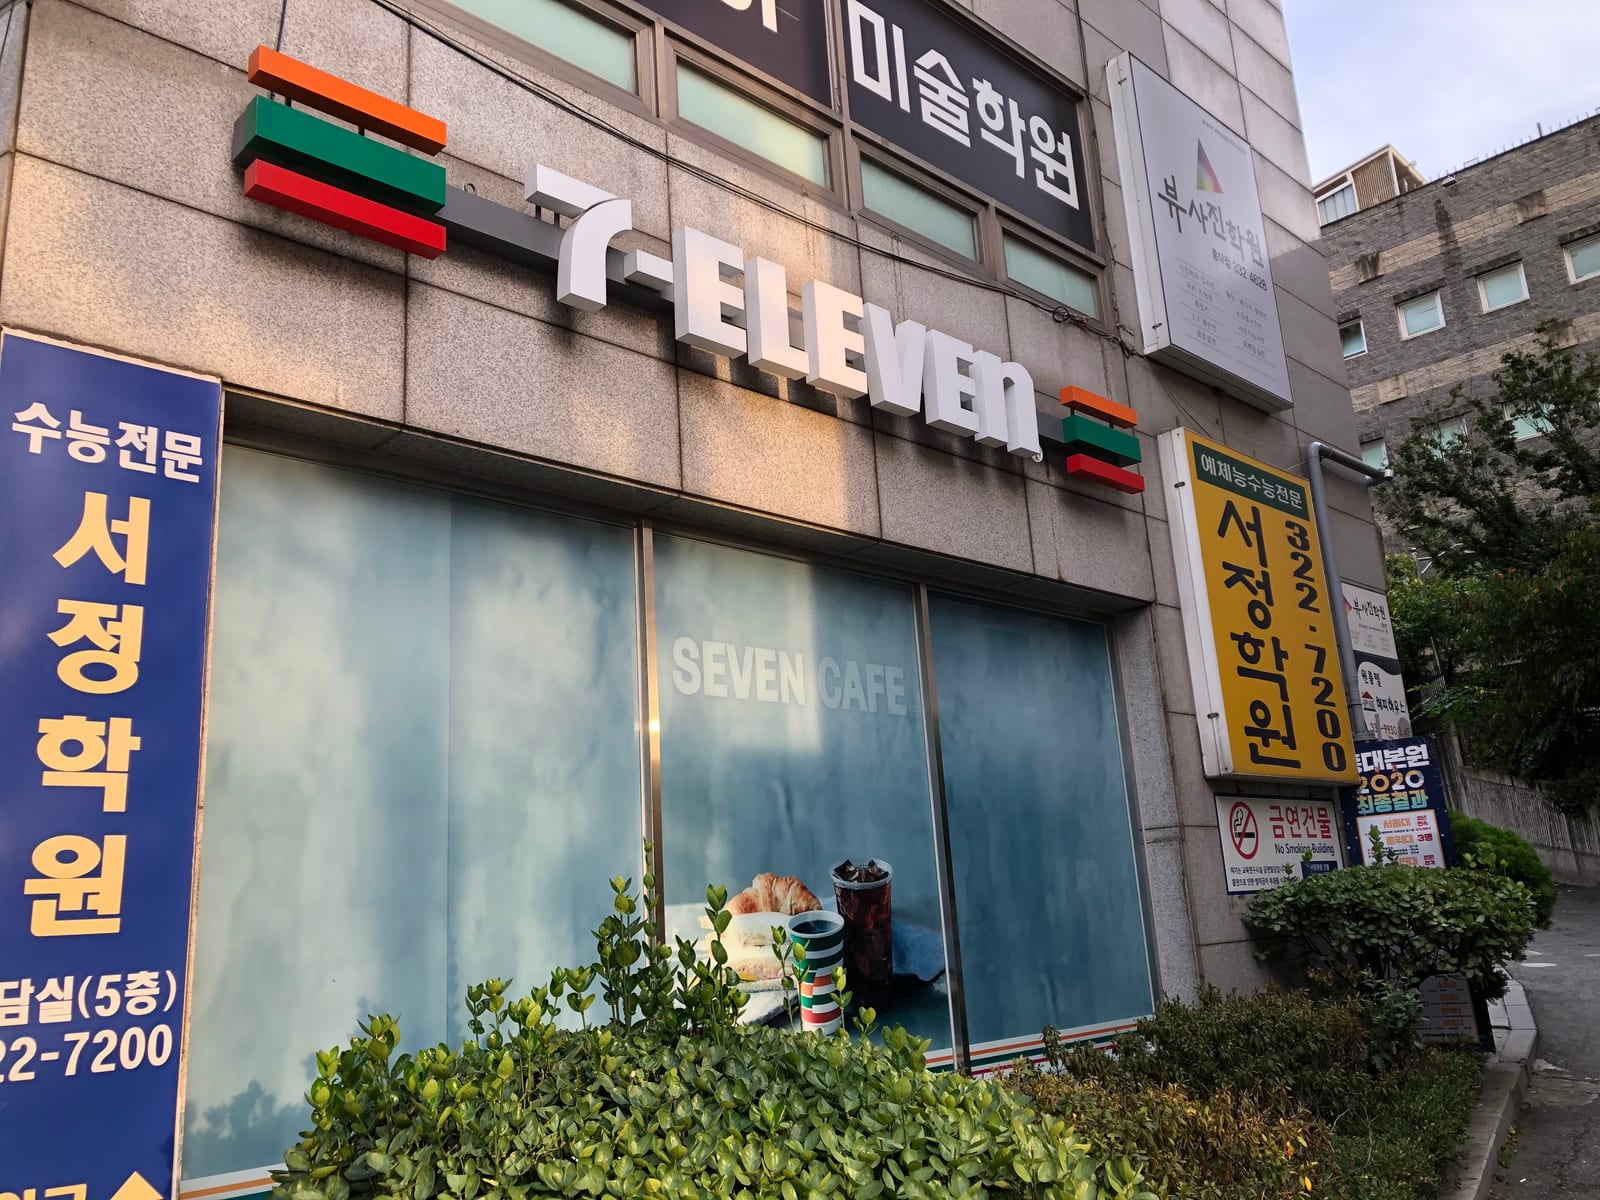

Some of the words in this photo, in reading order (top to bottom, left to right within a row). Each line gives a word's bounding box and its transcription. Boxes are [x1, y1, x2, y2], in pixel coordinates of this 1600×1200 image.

[847, 0, 1080, 210] 미술학원
[1158, 174, 1265, 269] 부사진학원
[12, 402, 203, 483] 수능전문
[1217, 499, 1301, 769] 서정학원
[24, 491, 151, 937] 서정학원
[672, 636, 806, 705] SEVEN
[818, 656, 908, 716] CAFE
[1358, 769, 1424, 794] 2020
[1269, 805, 1332, 839] 금연건물
[1275, 843, 1285, 855] No
[1311, 842, 1335, 857] Building
[0, 1024, 173, 1083] 2-7200
